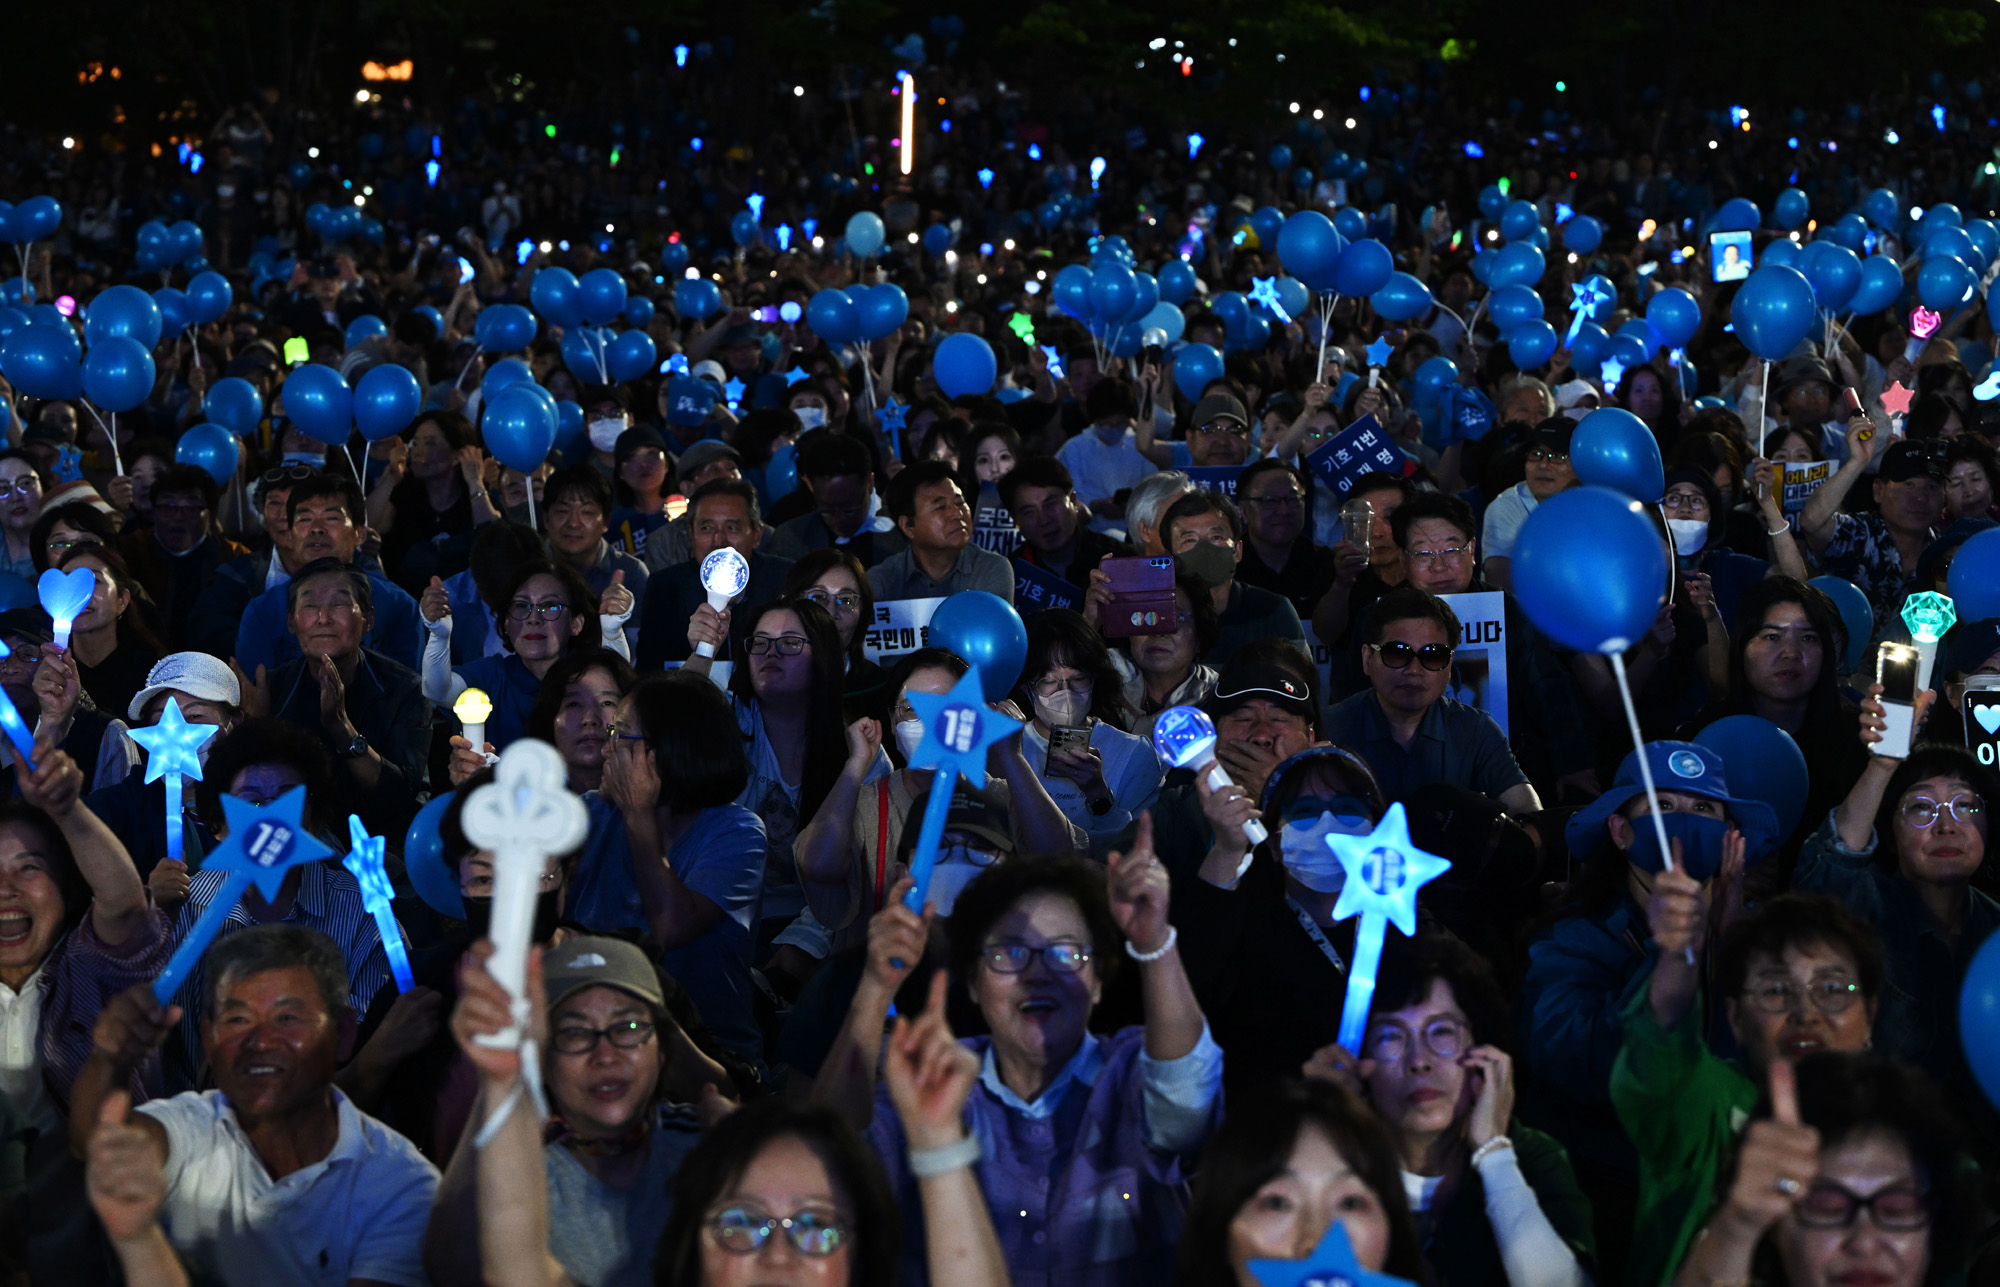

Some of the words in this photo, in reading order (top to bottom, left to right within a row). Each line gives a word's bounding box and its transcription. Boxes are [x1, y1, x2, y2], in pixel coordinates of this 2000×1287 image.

[1322, 447, 1353, 473] 기호
[1352, 429, 1378, 452] 1번
[978, 507, 1015, 528] 국민
[1016, 576, 1045, 602] 기호
[866, 627, 916, 651] 국민이
[1460, 620, 1503, 645] 니다
